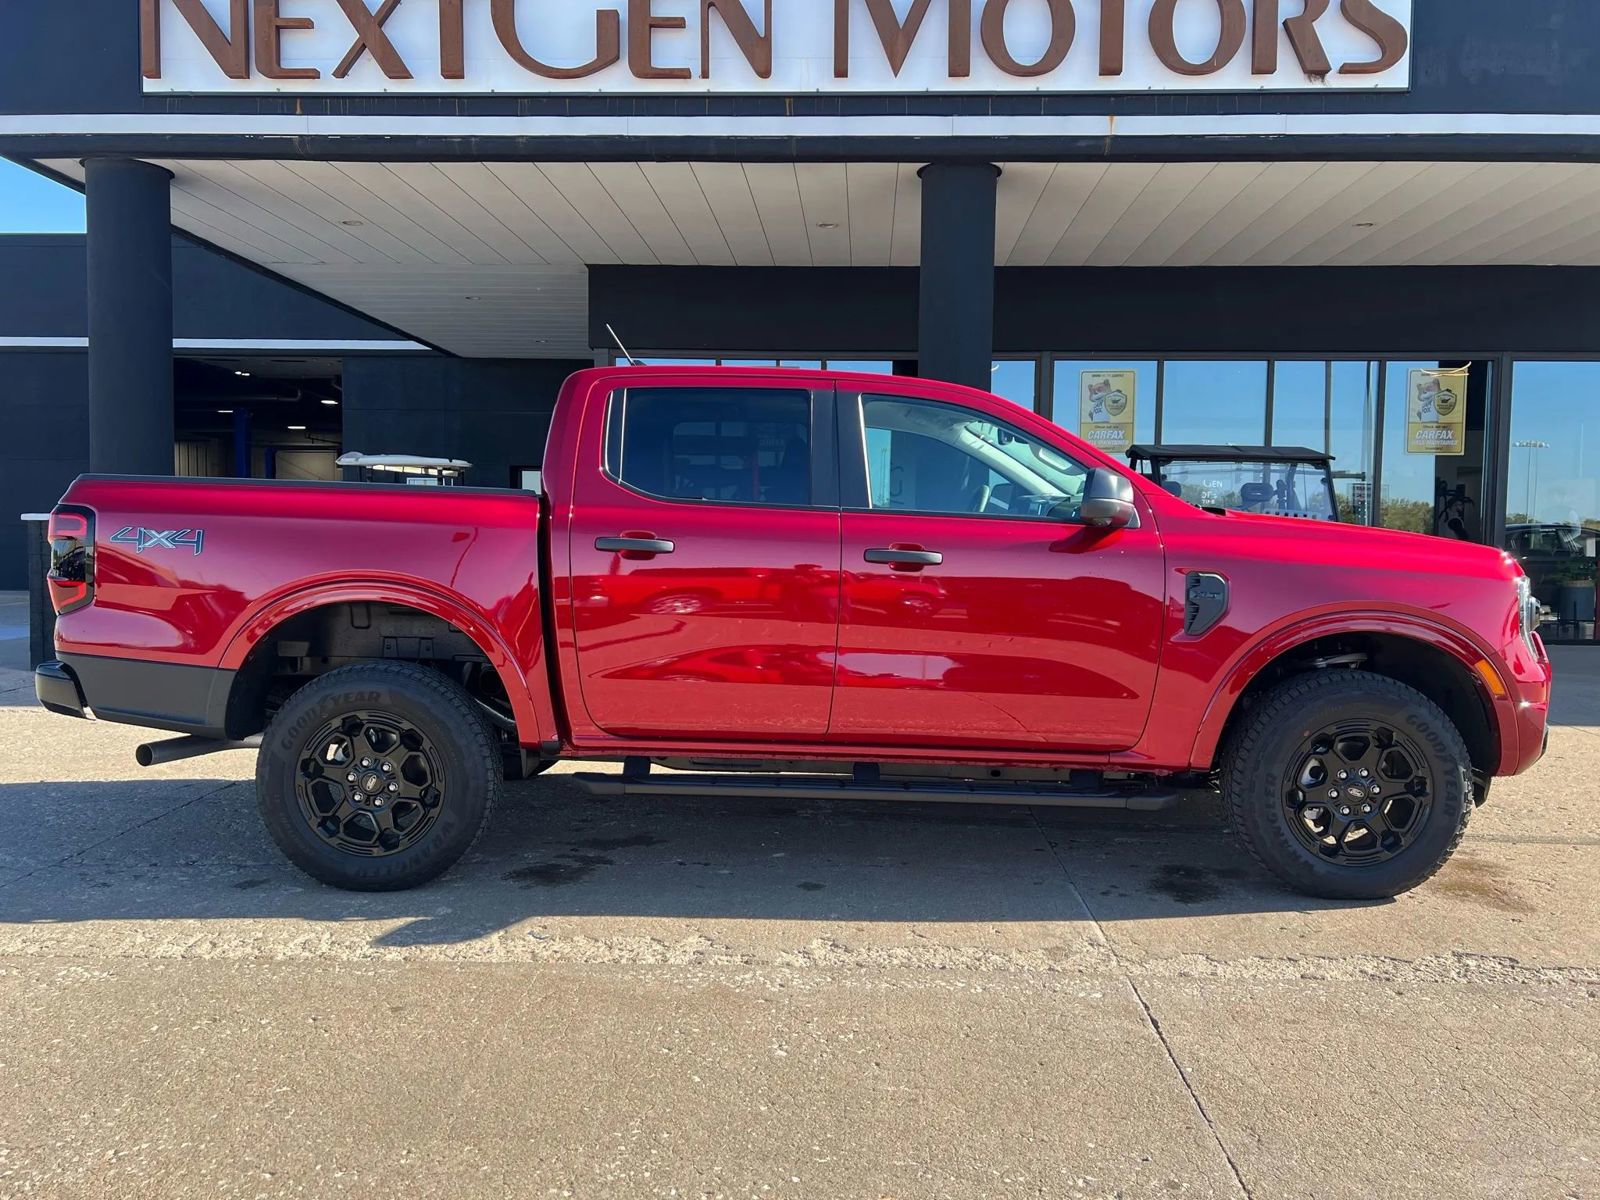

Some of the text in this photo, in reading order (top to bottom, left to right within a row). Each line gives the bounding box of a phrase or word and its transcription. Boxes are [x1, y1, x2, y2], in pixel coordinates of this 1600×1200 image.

[142, 0, 1408, 79] NEXTGEN MOTORS
[1088, 430, 1125, 439] CARFAX
[1415, 430, 1453, 439] CARFAX
[1405, 713, 1457, 817] GOODYEAR
